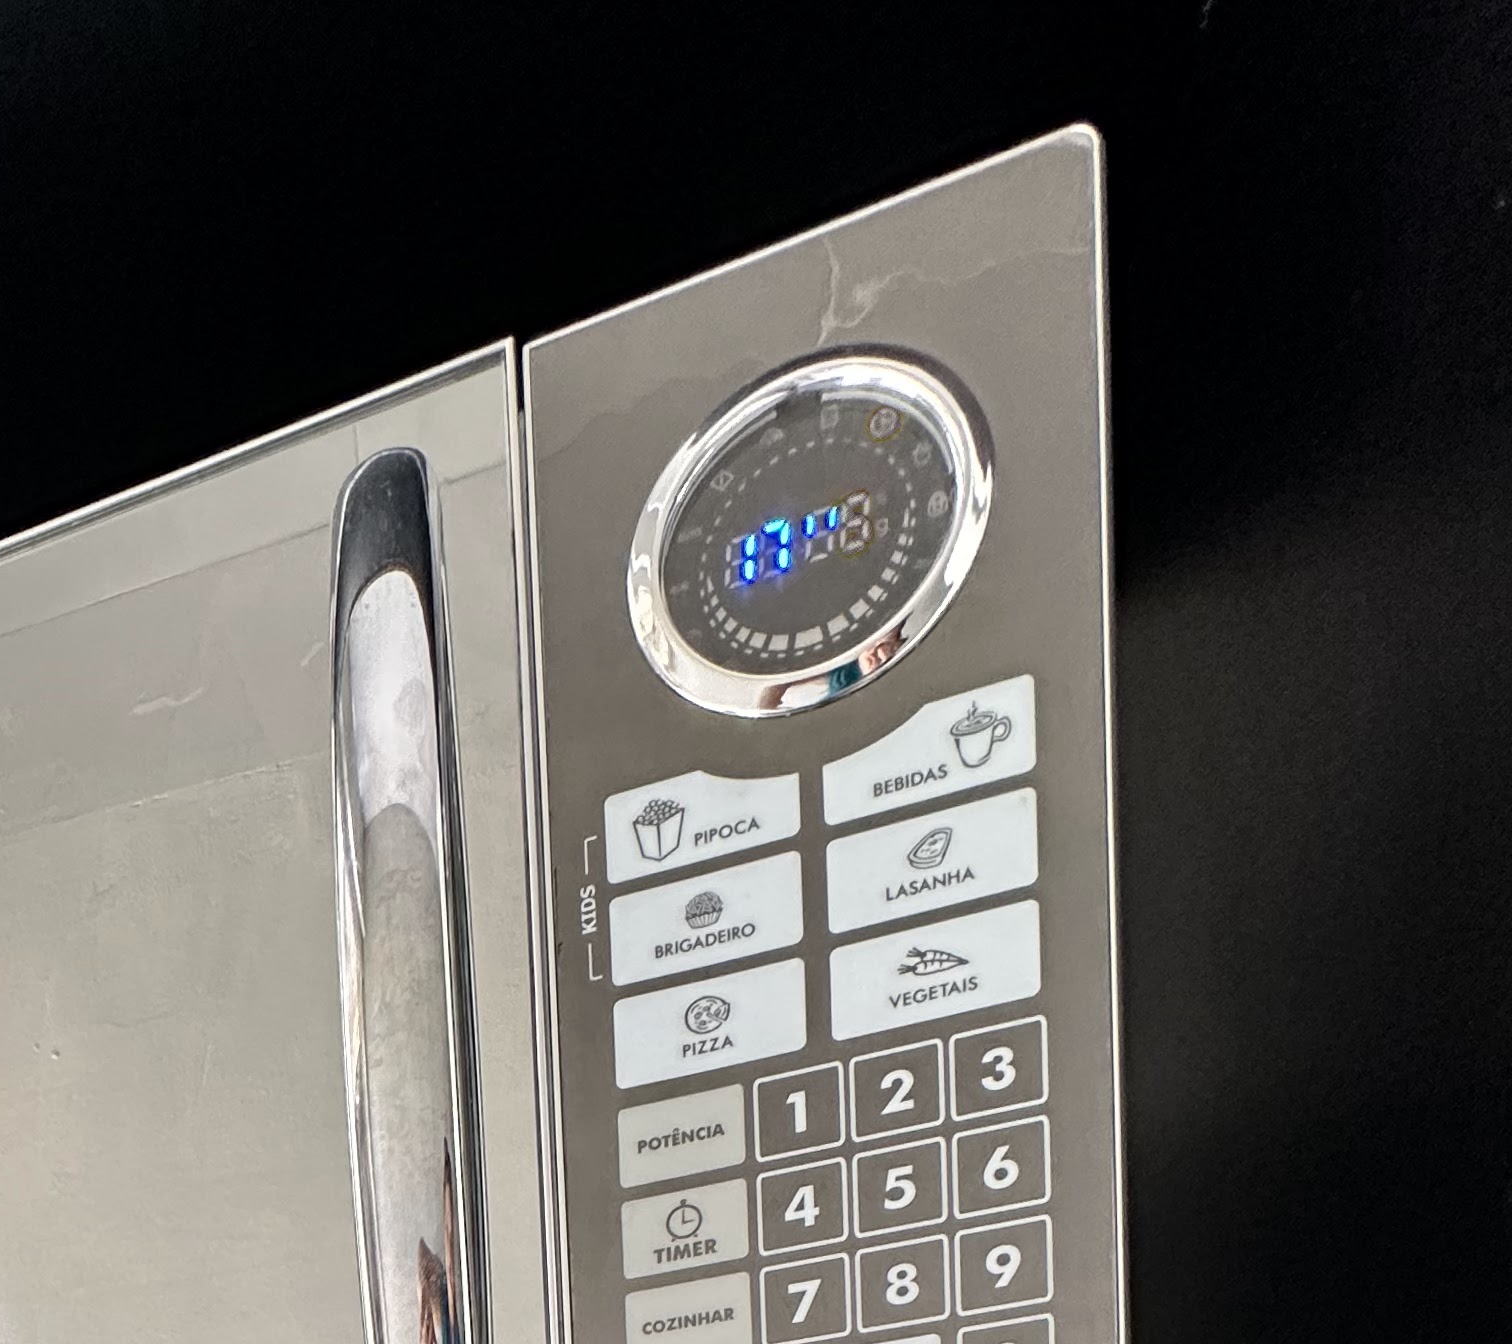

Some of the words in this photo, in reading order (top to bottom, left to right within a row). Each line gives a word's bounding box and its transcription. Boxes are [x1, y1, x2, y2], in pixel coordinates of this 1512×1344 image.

[872, 764, 949, 798] BEBIDAS
[693, 817, 761, 847] PIPOCA
[884, 866, 975, 902] LASANHA
[580, 884, 598, 935] KIDS
[653, 921, 757, 960] BRIGADEIRO
[888, 975, 979, 1009] VEGETAIS
[681, 1034, 734, 1059] PIZZA
[981, 1046, 1017, 1091] 3
[785, 1090, 808, 1134] 1
[880, 1068, 916, 1116] 2
[636, 1121, 726, 1155] POTÊNCIA
[883, 1165, 917, 1210] 5
[983, 1144, 1020, 1190] 6
[784, 1184, 821, 1228] 4
[653, 1237, 718, 1265] TIMER
[985, 1244, 1022, 1289] 9
[787, 1279, 822, 1324] 7
[886, 1262, 920, 1306] 8
[641, 1306, 735, 1336] COZINHAR
